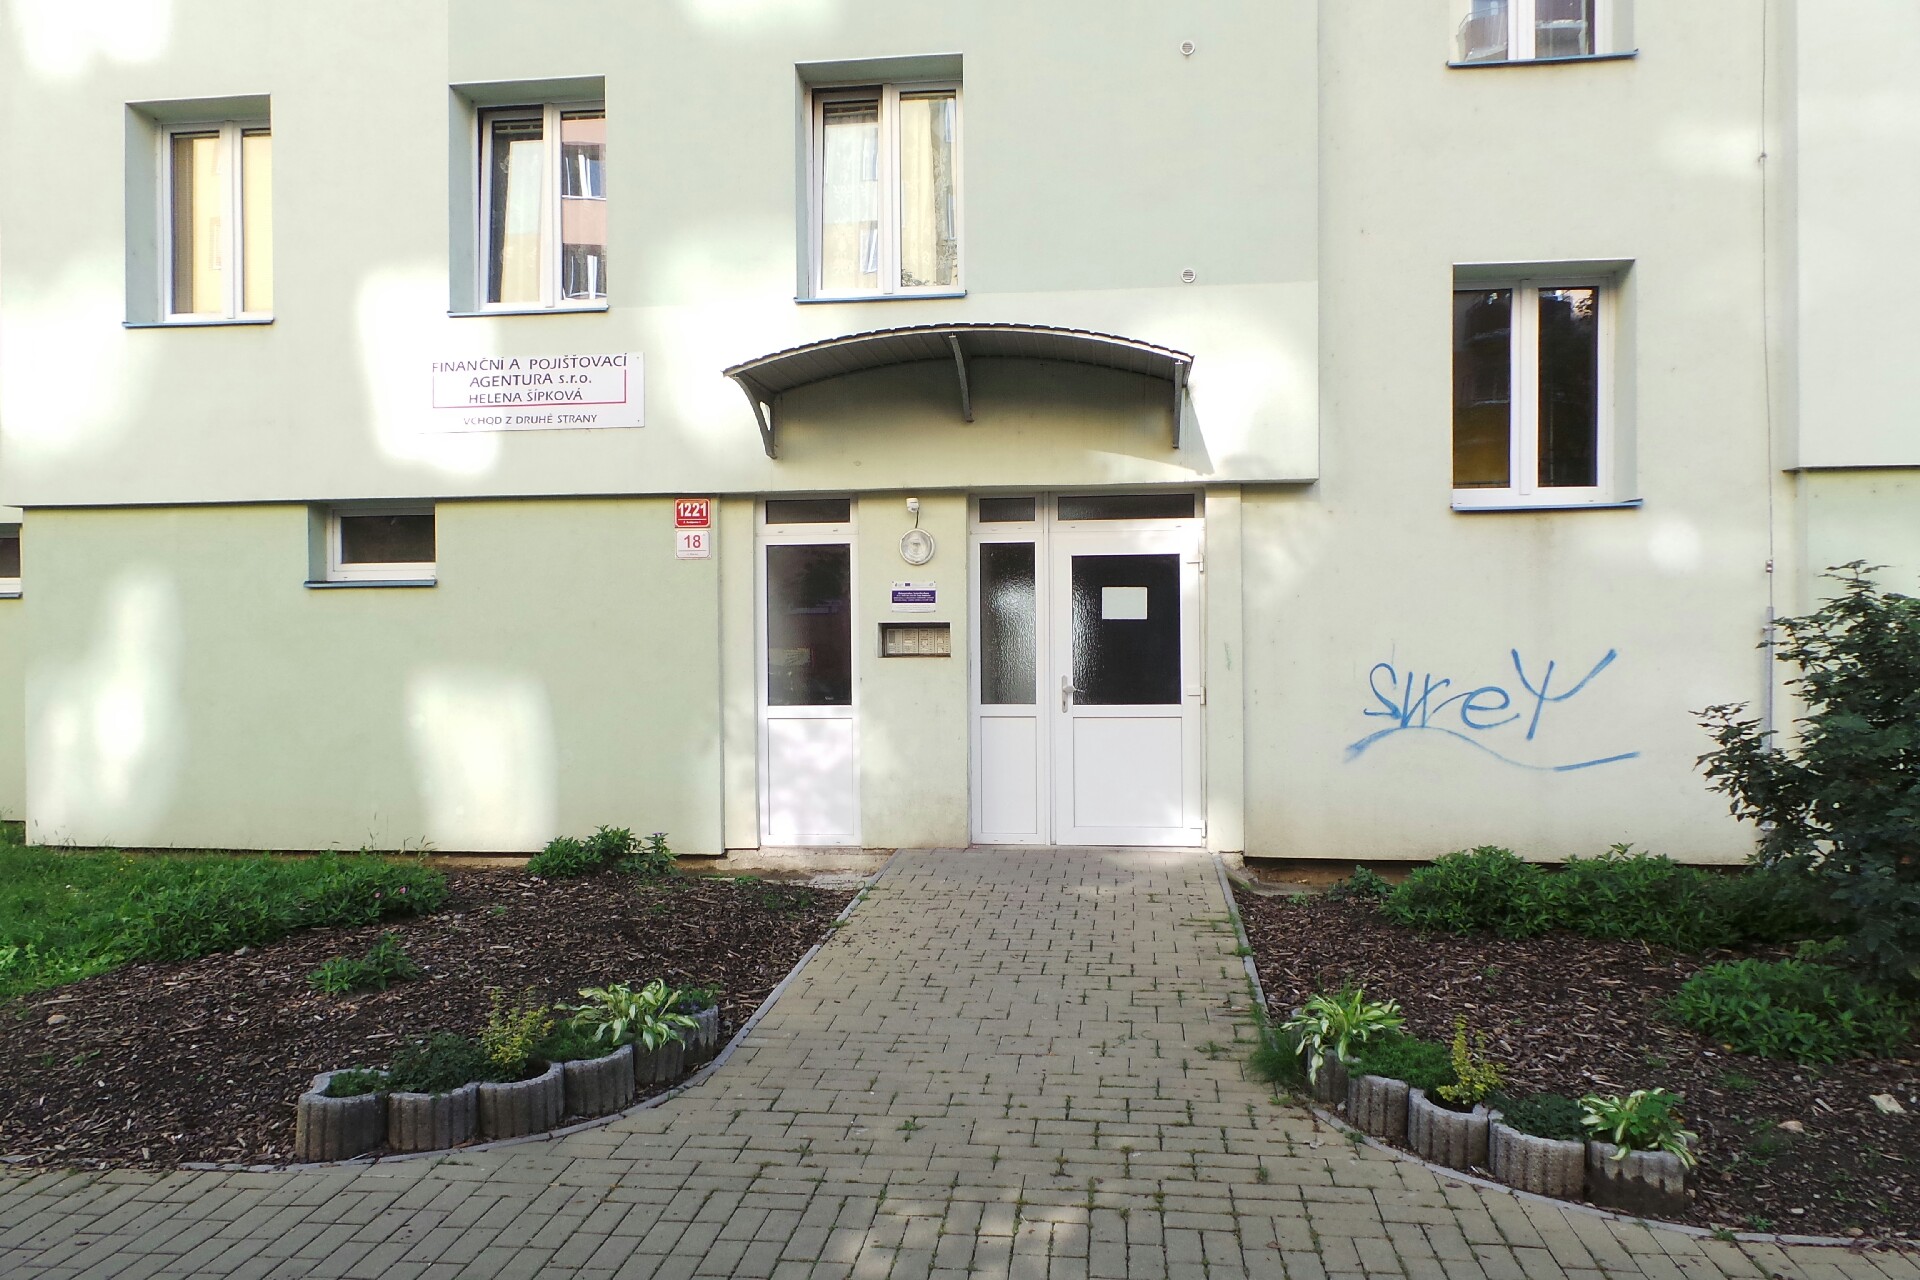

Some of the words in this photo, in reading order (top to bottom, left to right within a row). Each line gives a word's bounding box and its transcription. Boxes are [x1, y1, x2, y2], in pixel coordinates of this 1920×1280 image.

[432, 356, 504, 373] FINANČNÍ
[508, 358, 521, 370] A
[529, 352, 627, 370] POJIŠŤOVACÍ
[469, 373, 553, 388] AGENTURA
[558, 374, 592, 384] s.r.o.
[469, 392, 522, 404] HELENA
[527, 387, 583, 402] ŠÍPKOVÁ
[464, 416, 502, 425] VCHOD
[505, 416, 513, 425] Z
[516, 412, 553, 424] DRUHÉ
[557, 414, 597, 424] STRANY
[678, 502, 707, 517] 1221
[684, 534, 701, 549] 18
